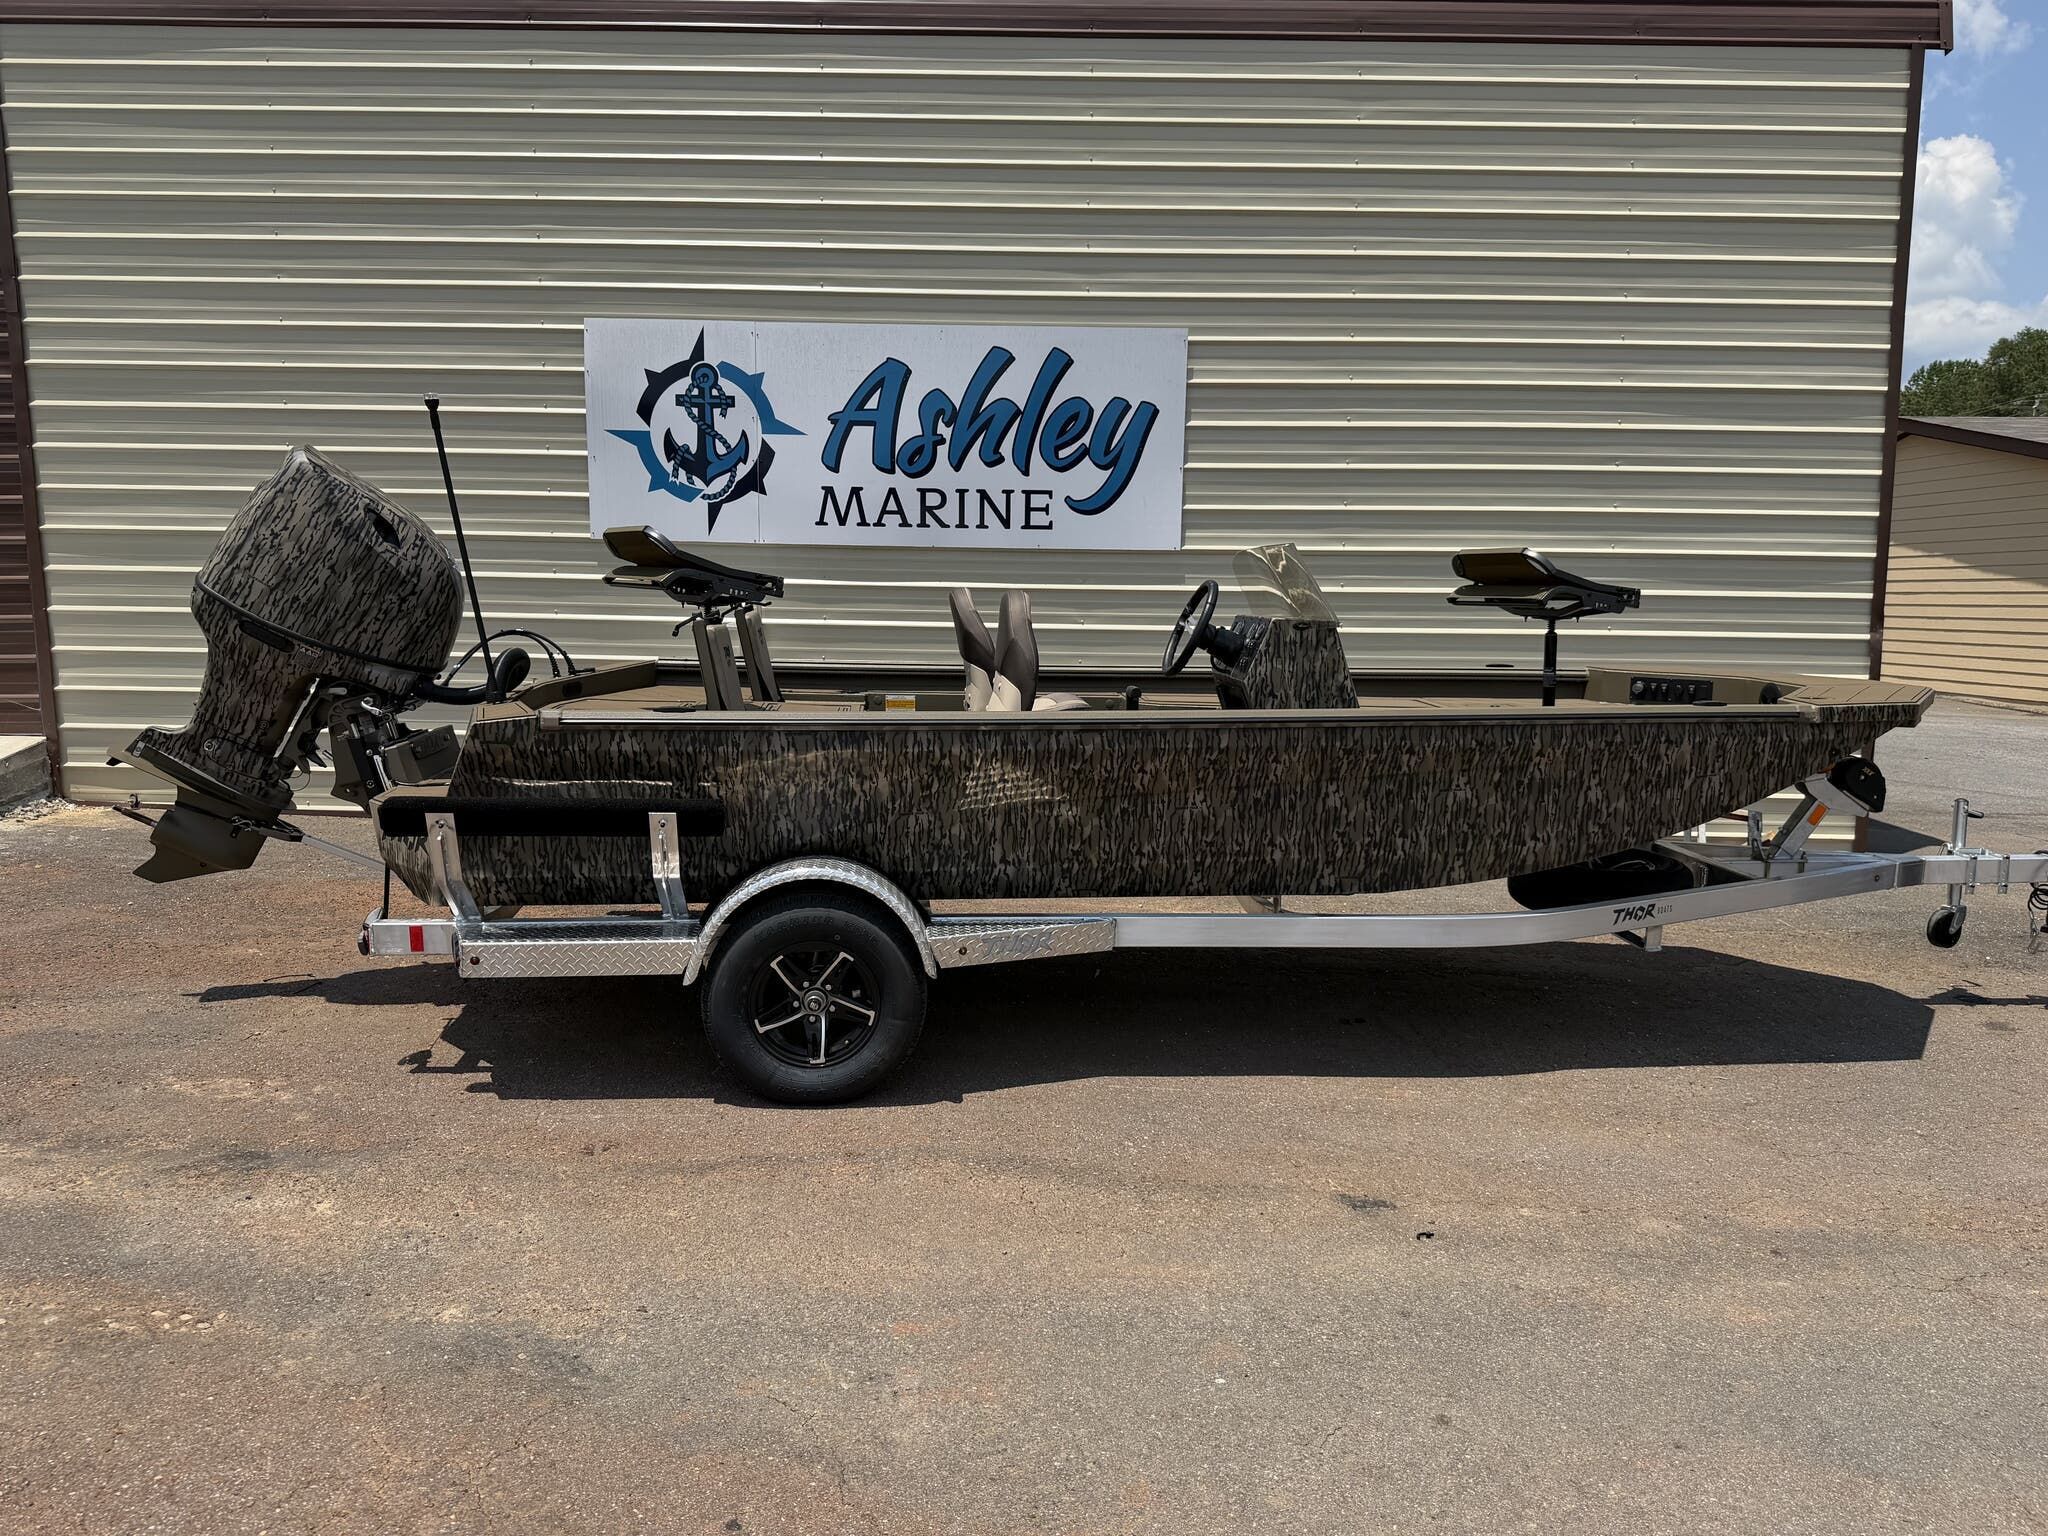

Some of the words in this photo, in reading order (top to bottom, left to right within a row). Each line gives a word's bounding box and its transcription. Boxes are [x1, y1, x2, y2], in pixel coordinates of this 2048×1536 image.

[821, 346, 1160, 516] Ashley
[815, 486, 1054, 531] MARINE
[1613, 904, 1656, 925] THOR
